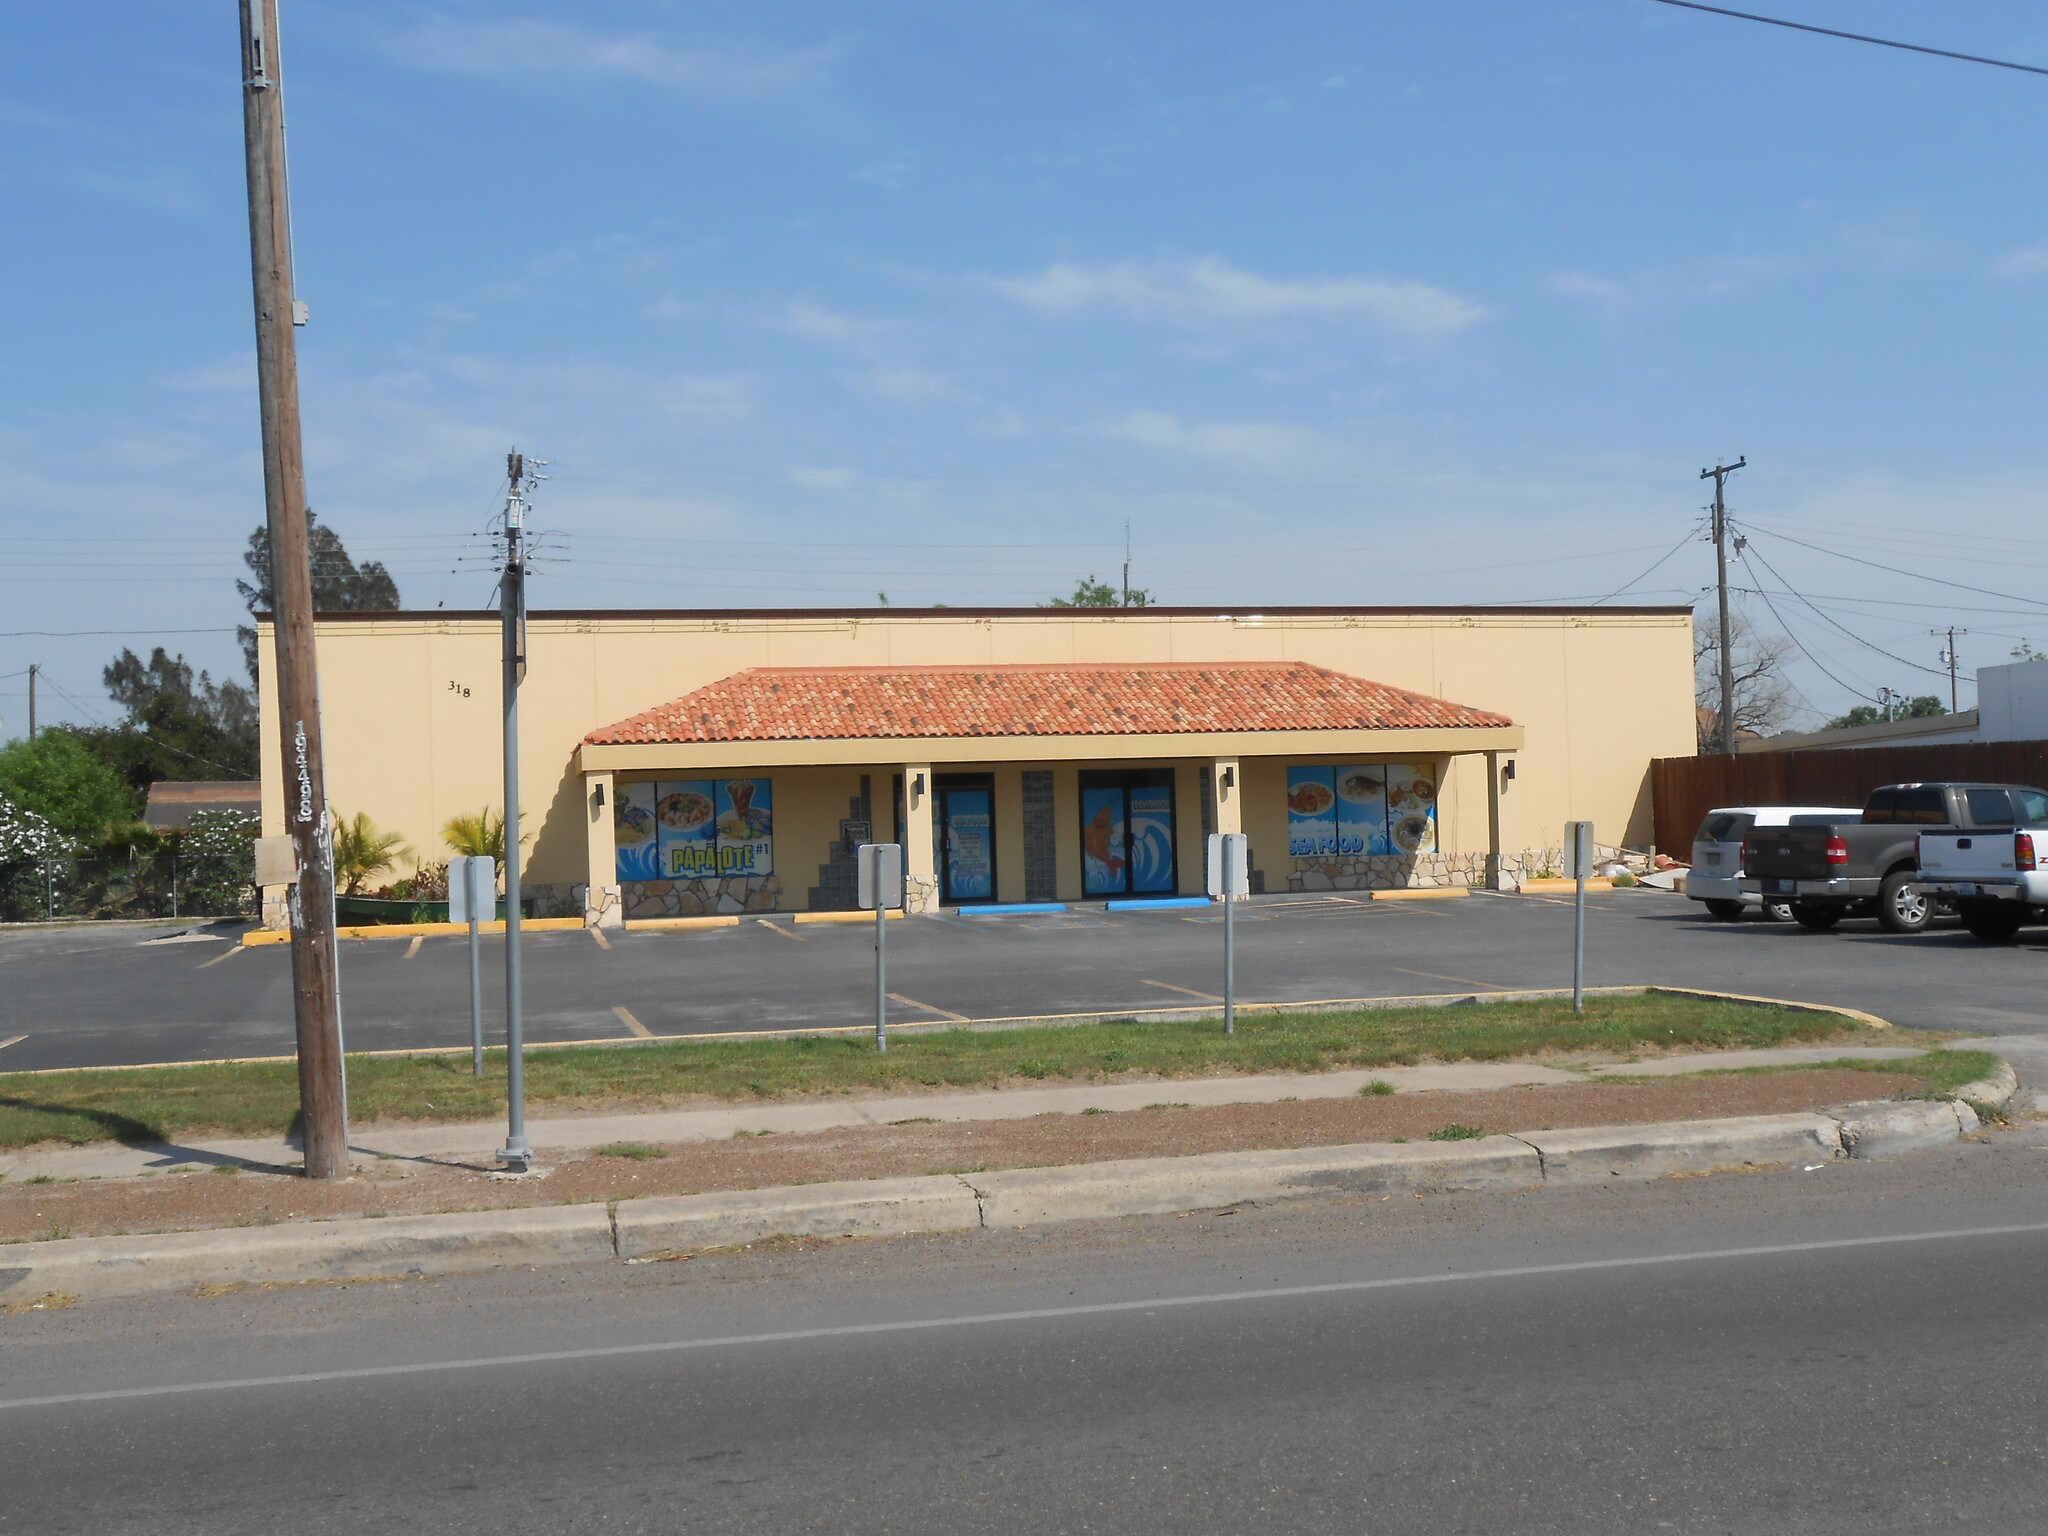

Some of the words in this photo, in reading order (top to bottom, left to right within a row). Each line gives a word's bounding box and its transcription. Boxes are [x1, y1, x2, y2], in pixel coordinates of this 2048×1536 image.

[447, 680, 471, 698] 318
[671, 844, 755, 874] PAPALOTE
[755, 843, 769, 855] #1
